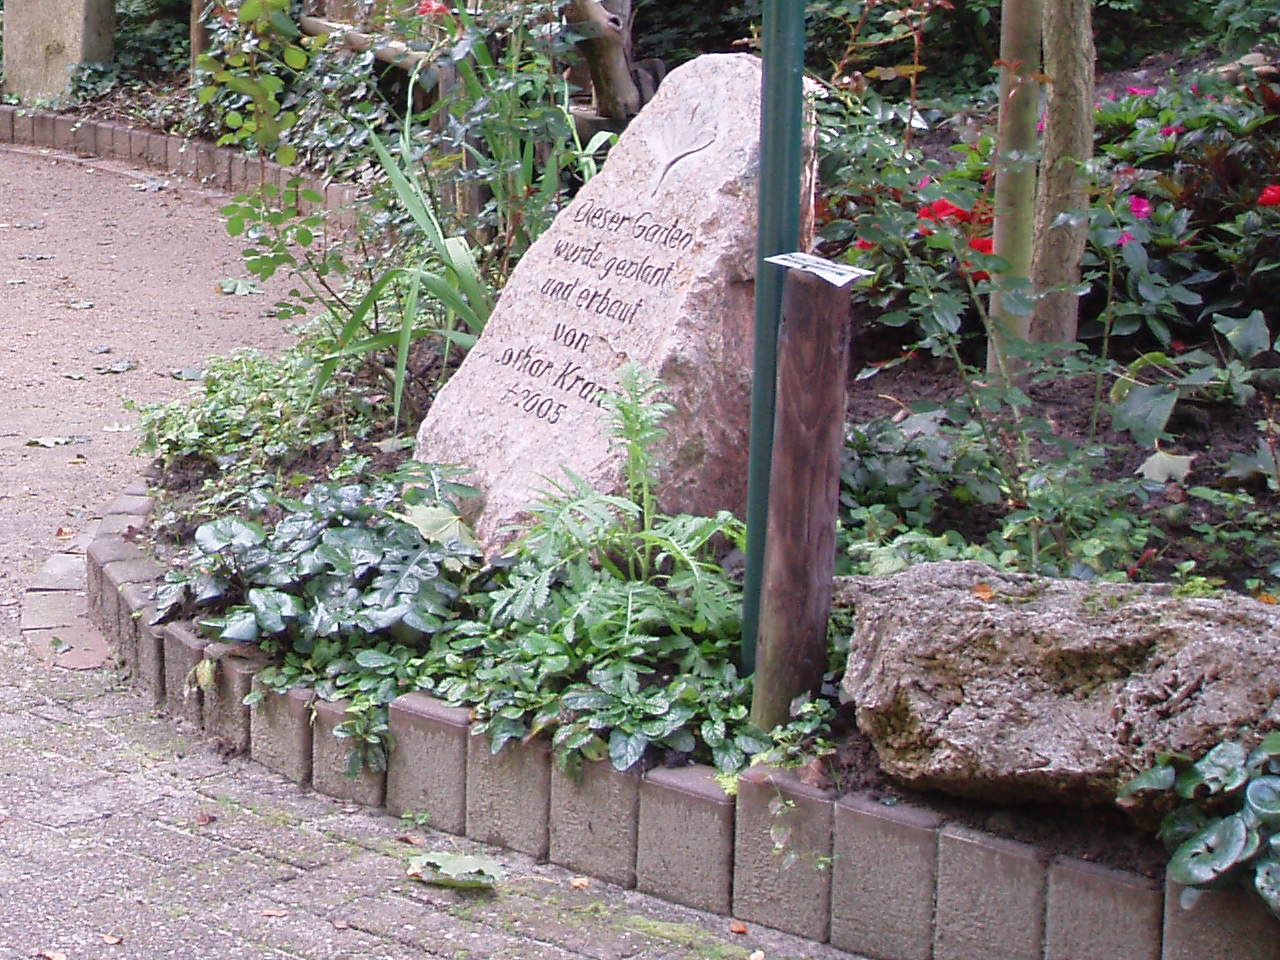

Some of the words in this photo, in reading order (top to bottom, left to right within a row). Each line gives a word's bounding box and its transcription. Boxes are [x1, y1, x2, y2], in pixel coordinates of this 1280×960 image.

[573, 198, 631, 232] Dieser
[632, 211, 694, 250] Garten
[554, 239, 603, 269] wurde
[598, 256, 675, 288] geplant
[540, 277, 580, 302] und
[575, 287, 643, 325] erbaut
[553, 322, 591, 354] von
[494, 344, 555, 378] othar
[552, 360, 613, 412] Kran
